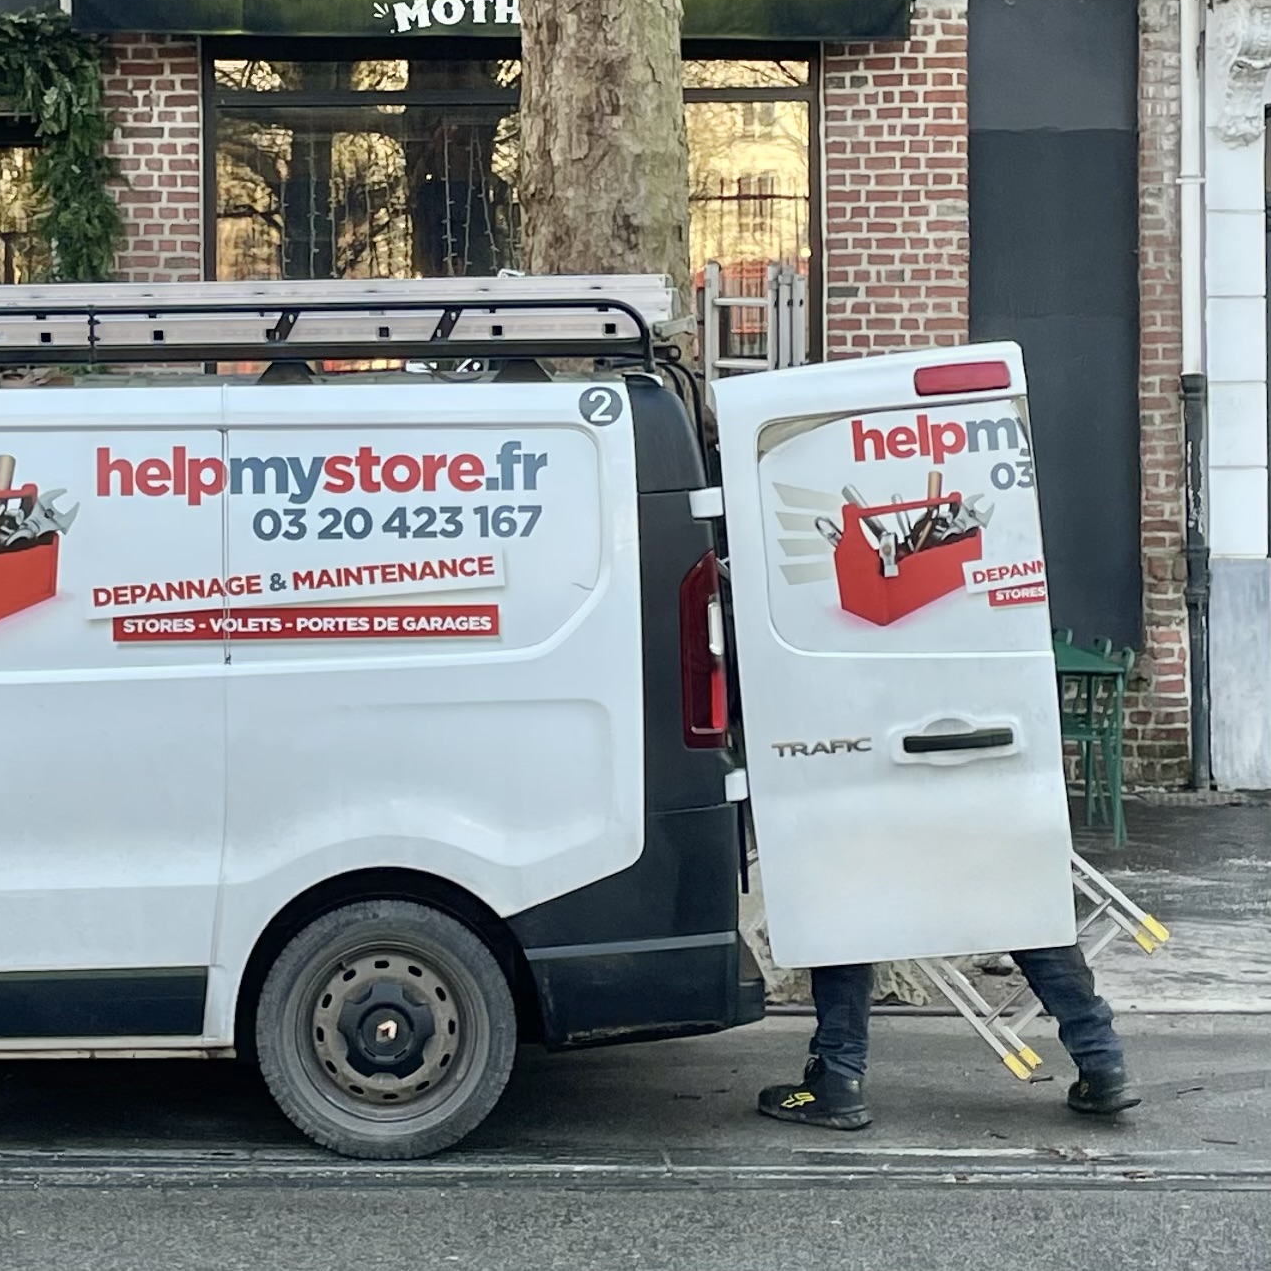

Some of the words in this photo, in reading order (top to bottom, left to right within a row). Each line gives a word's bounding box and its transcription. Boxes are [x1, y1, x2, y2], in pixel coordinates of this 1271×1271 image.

[588, 390, 613, 423] 2
[851, 414, 1031, 465] helpm
[95, 440, 549, 506] helpmystore.fr
[990, 461, 1035, 491] 03
[252, 508, 307, 541] 03
[317, 507, 373, 540] 20
[381, 506, 464, 540] 423
[472, 504, 543, 539] 167
[92, 574, 263, 608] DEPANNAGE
[269, 572, 288, 592] &
[292, 555, 496, 590] MAINTENANCE
[995, 585, 1047, 602] STORES
[122, 617, 196, 634] STORES
[209, 616, 282, 633] VOLETS
[295, 616, 371, 633] PORTES
[373, 616, 401, 632] DE
[402, 615, 493, 632] GARAGES
[771, 736, 873, 758] TRAFIC
